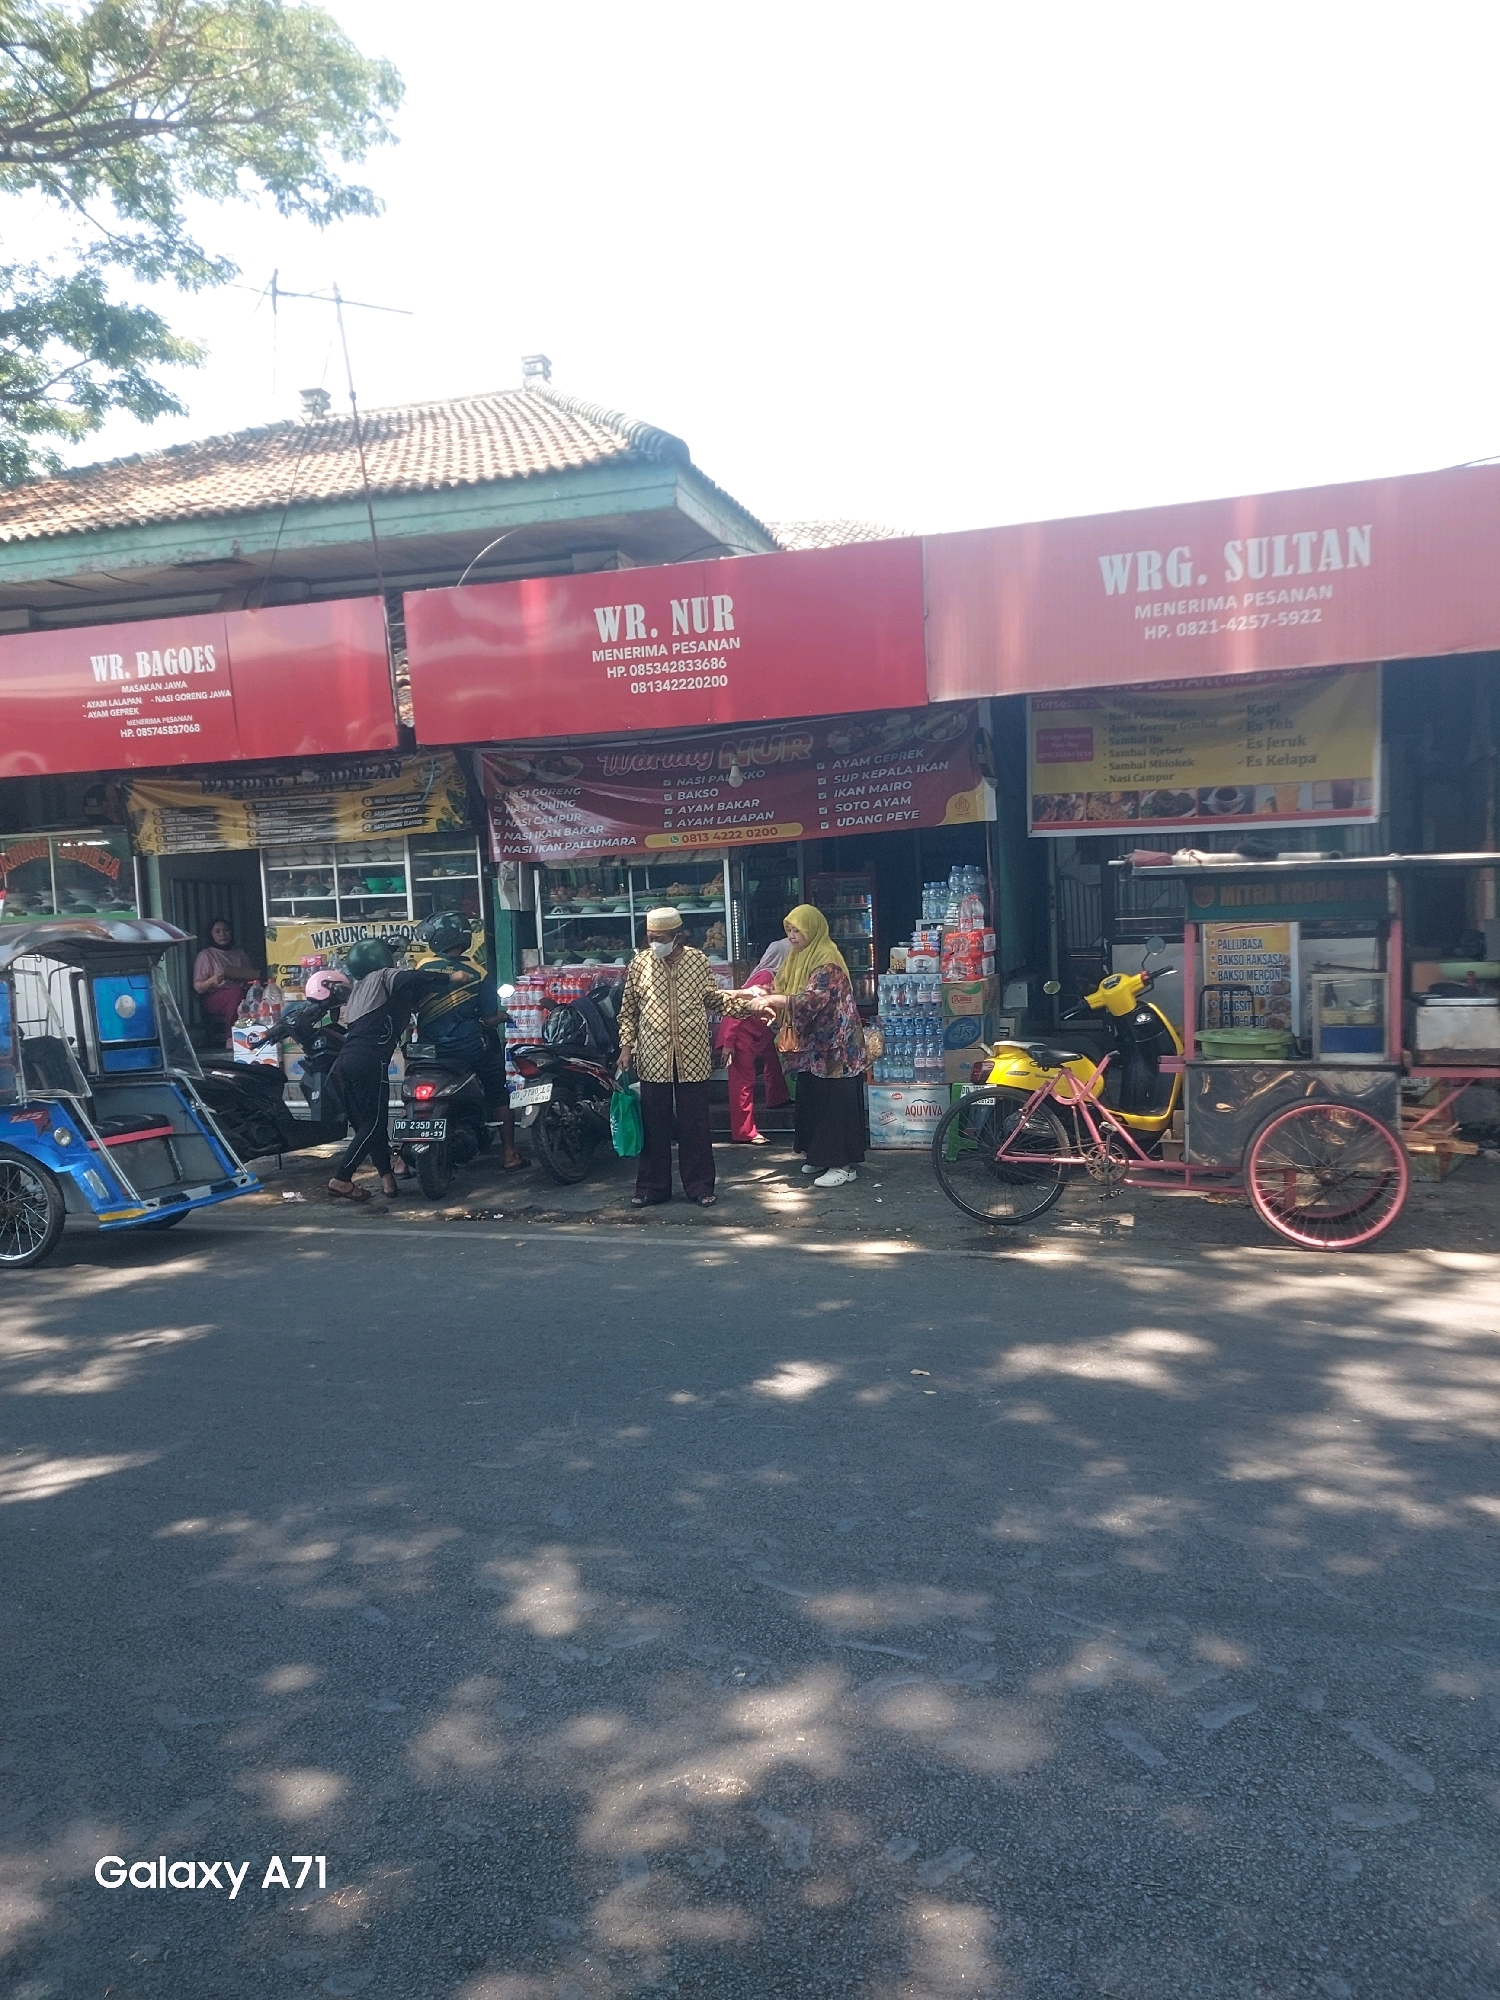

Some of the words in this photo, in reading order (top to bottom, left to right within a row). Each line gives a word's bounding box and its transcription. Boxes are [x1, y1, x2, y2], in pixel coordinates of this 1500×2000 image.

[1098, 546, 1207, 596] WRG.
[1223, 524, 1373, 583] SULTAN
[1134, 596, 1237, 620] MENERIMA
[1243, 584, 1334, 607] PESANAN
[594, 603, 658, 644] WR.
[670, 594, 736, 637] NUR
[1144, 626, 1171, 640] HP.
[1176, 607, 1323, 636] 0821-4257-5922
[592, 644, 669, 663] MENERIMA
[672, 637, 741, 656] PESANAN
[90, 655, 131, 683] WR.
[136, 644, 217, 679] BAGOES
[606, 665, 627, 679] HP.
[629, 657, 728, 677] 085342833686
[121, 683, 162, 693] MASAKAN
[163, 680, 188, 690] JAWA
[630, 674, 728, 694] 081342220200
[86, 700, 107, 709] AYAM
[155, 694, 174, 703] NASI
[175, 691, 208, 702] GORENG
[209, 689, 232, 698] JAWA
[88, 709, 109, 719] AYAM
[111, 707, 139, 717] GEPREK
[162, 714, 193, 724] PESANAN
[120, 729, 135, 738] HP.
[1246, 738, 1262, 750] Es
[1266, 734, 1307, 750] Jeruk
[597, 747, 715, 776] Warung
[719, 732, 815, 769] NUR
[832, 759, 870, 770] AYAM
[874, 748, 925, 765] GEPREK
[1246, 755, 1263, 767] Es
[1266, 753, 1317, 767] Kelapa
[833, 774, 860, 785] SUP
[862, 766, 915, 781] KEPALA
[917, 760, 949, 773] IKAN
[1109, 761, 1147, 771] Sambal
[677, 777, 705, 787] NASI
[1109, 774, 1131, 783] Nasi
[1133, 773, 1175, 784] Campur
[505, 789, 529, 801] NASI
[532, 787, 582, 797] GORENG
[677, 788, 719, 800] BAKSO
[834, 786, 866, 799] IKAN
[868, 780, 913, 794] MAIRO
[505, 804, 530, 814] NASI
[532, 800, 576, 812] KUNING
[677, 802, 714, 814] AYAM
[717, 799, 760, 811] BAKAR
[835, 801, 870, 813] SOTO
[873, 796, 912, 809] AYAM
[505, 818, 531, 827] NASI
[534, 813, 582, 825] CAMPUR
[677, 815, 715, 828] AYAM
[717, 810, 774, 823] LALAPAN
[837, 815, 884, 828] UDANG
[886, 810, 920, 822] PEYE
[504, 832, 532, 841] NASI
[534, 829, 561, 839] IKAN
[563, 825, 605, 837] BAKAR
[682, 832, 709, 844] 0813
[712, 829, 742, 842] 4222
[746, 826, 778, 839] 0200
[503, 845, 532, 854] NASI
[534, 843, 562, 853] IKAN
[565, 837, 637, 850] PALLUMARA
[311, 925, 368, 951] WARUNG
[1217, 938, 1264, 951] PALLUBASA
[1217, 954, 1245, 966] BAKSO
[1246, 953, 1285, 966] RAKSASA
[1217, 970, 1245, 982] BAKSO
[1246, 969, 1282, 982] MERCON
[905, 1104, 943, 1118] AQUVIVA
[433, 1120, 445, 1130] PZ
